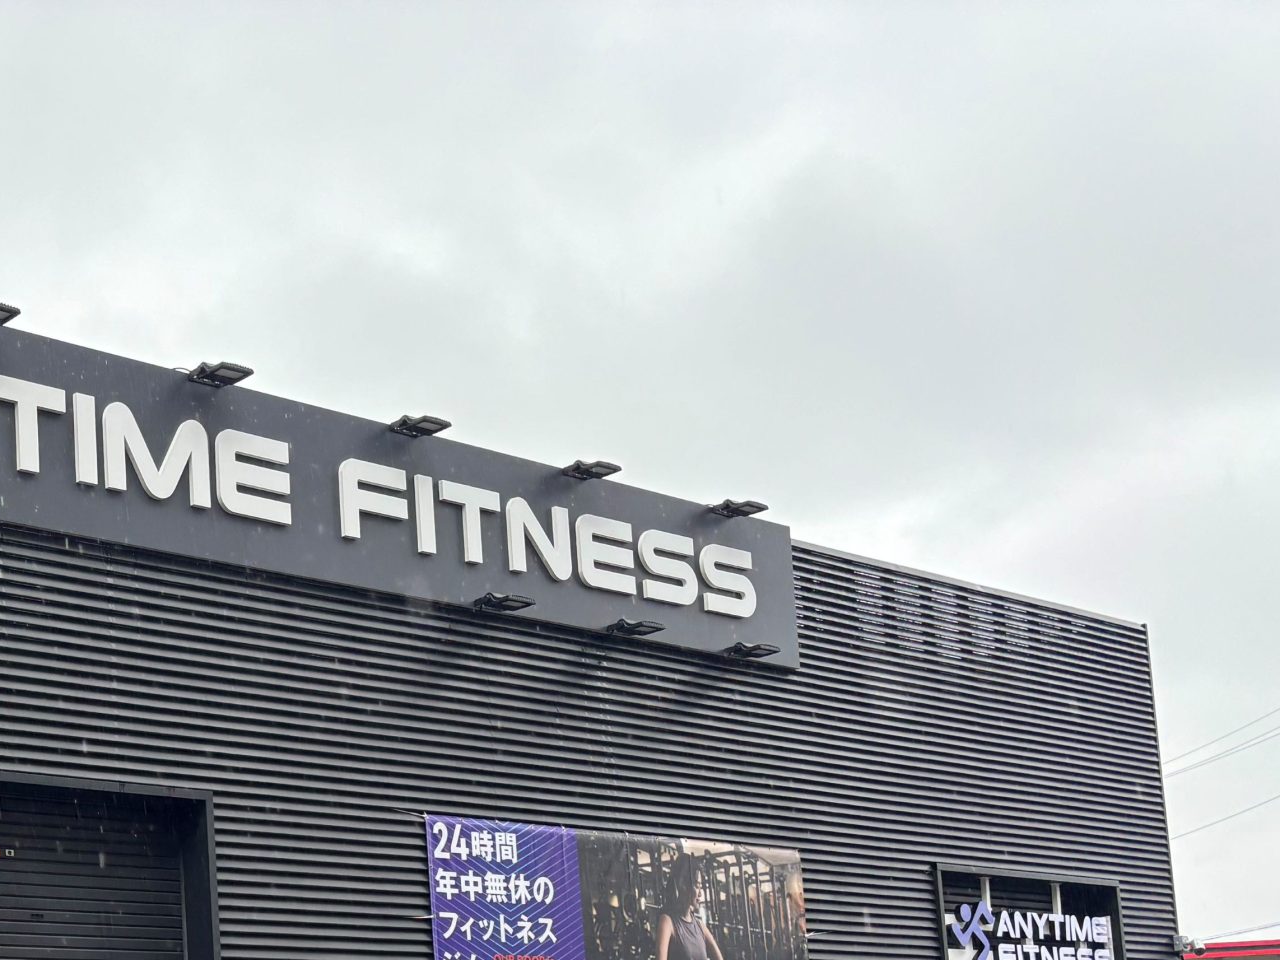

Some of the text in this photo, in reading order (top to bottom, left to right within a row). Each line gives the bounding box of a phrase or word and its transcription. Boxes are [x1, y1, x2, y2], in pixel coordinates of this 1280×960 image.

[337, 457, 758, 619] FITNESS
[432, 821, 518, 864] 24時間
[435, 868, 555, 905] 年中無休の
[438, 911, 558, 945] フィットネス
[996, 910, 1109, 943] ANYTIME
